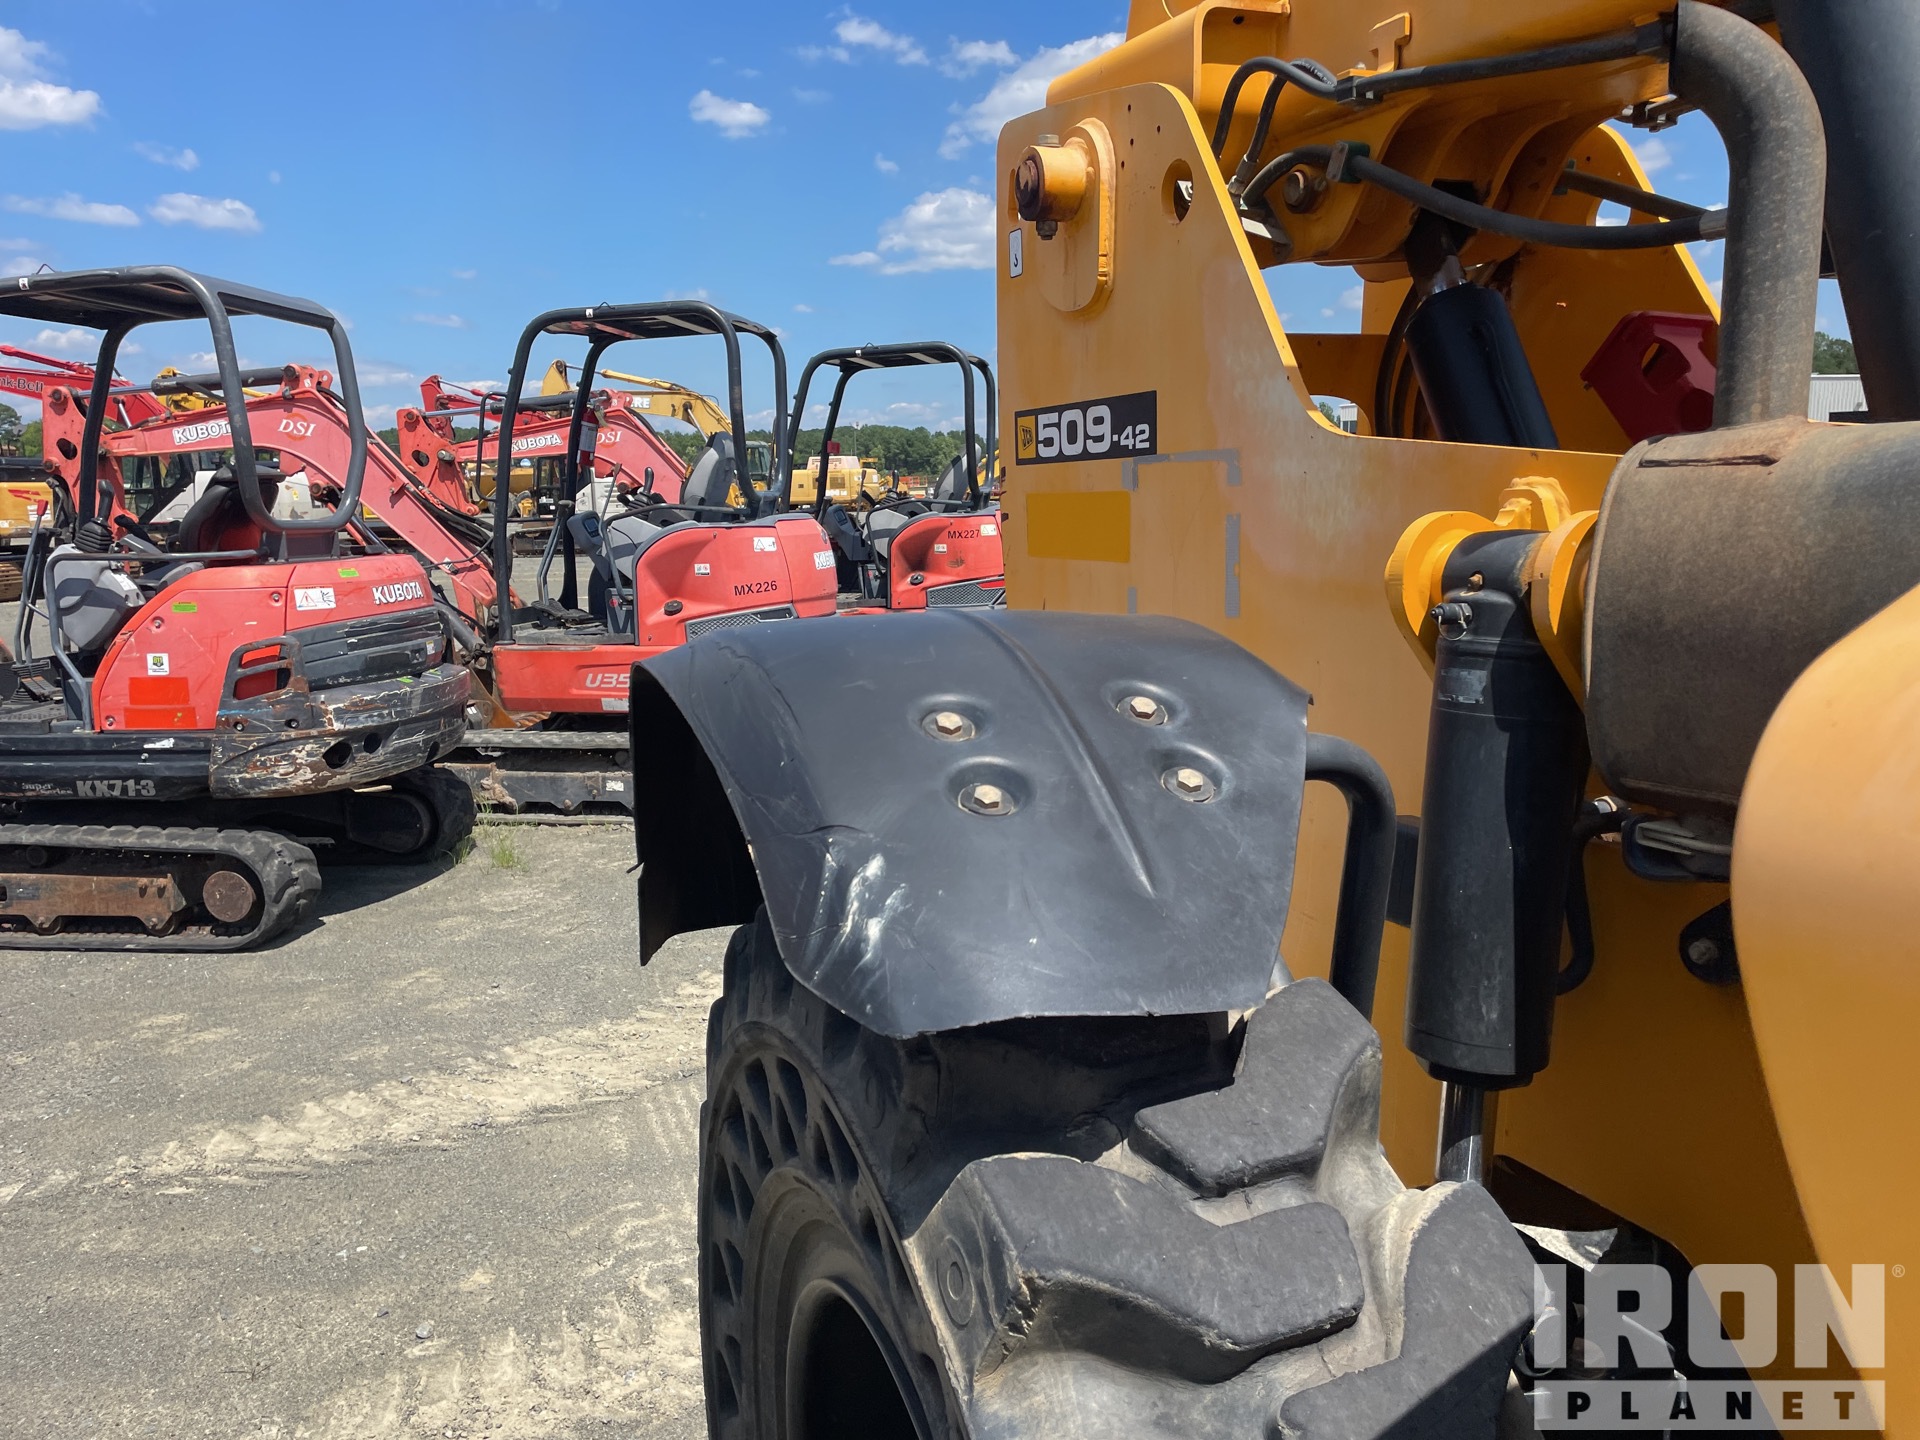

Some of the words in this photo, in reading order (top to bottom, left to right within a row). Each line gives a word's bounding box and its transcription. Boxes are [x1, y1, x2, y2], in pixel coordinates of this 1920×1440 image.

[278, 418, 316, 437] DSI
[947, 529, 980, 539] MX227
[372, 581, 424, 605] KUBOTA
[734, 580, 778, 596] MX226
[76, 779, 156, 797] KX71-3
